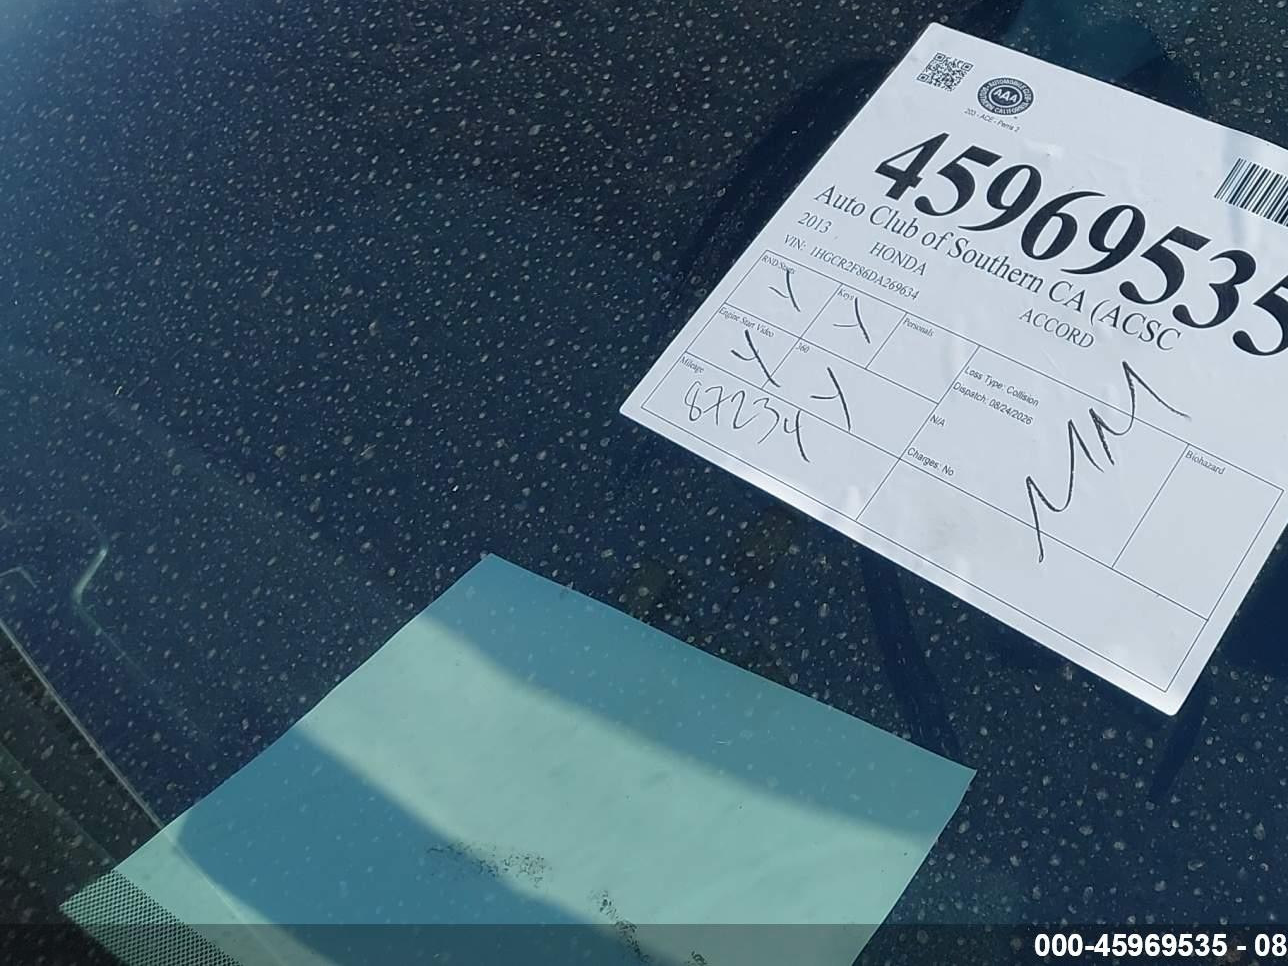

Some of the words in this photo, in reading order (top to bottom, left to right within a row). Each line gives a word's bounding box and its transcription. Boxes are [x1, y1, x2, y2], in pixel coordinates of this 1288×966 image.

[993, 88, 1018, 103] AAA
[761, 254, 779, 266] RND
[783, 234, 807, 252] VIN:
[810, 246, 920, 301] 1HGCR2F86DA269634
[814, 184, 865, 217] Auto
[869, 205, 919, 239] Club
[921, 230, 954, 251] of
[947, 237, 1044, 294] Southern
[1048, 280, 1086, 313] CA
[1090, 299, 1182, 352] (ACSC
[798, 212, 832, 233] 2013
[869, 241, 928, 276] HONDA
[1018, 307, 1095, 349] ACCORD
[837, 286, 854, 301] Keys
[718, 306, 740, 324] Engine
[740, 315, 756, 329] Start
[755, 323, 775, 338] Video
[903, 317, 934, 337] Personals
[796, 342, 810, 354] 360
[679, 356, 705, 374] Mileage
[964, 366, 983, 381] Loss
[985, 375, 1004, 390] Type:
[1006, 385, 1039, 407] Collision
[952, 381, 988, 404] Dispatch:
[988, 399, 1034, 426] 08/24/2026
[929, 414, 946, 427] N/A
[907, 447, 940, 469] Charges:
[942, 465, 954, 477] No
[1184, 450, 1226, 476] Biohazard
